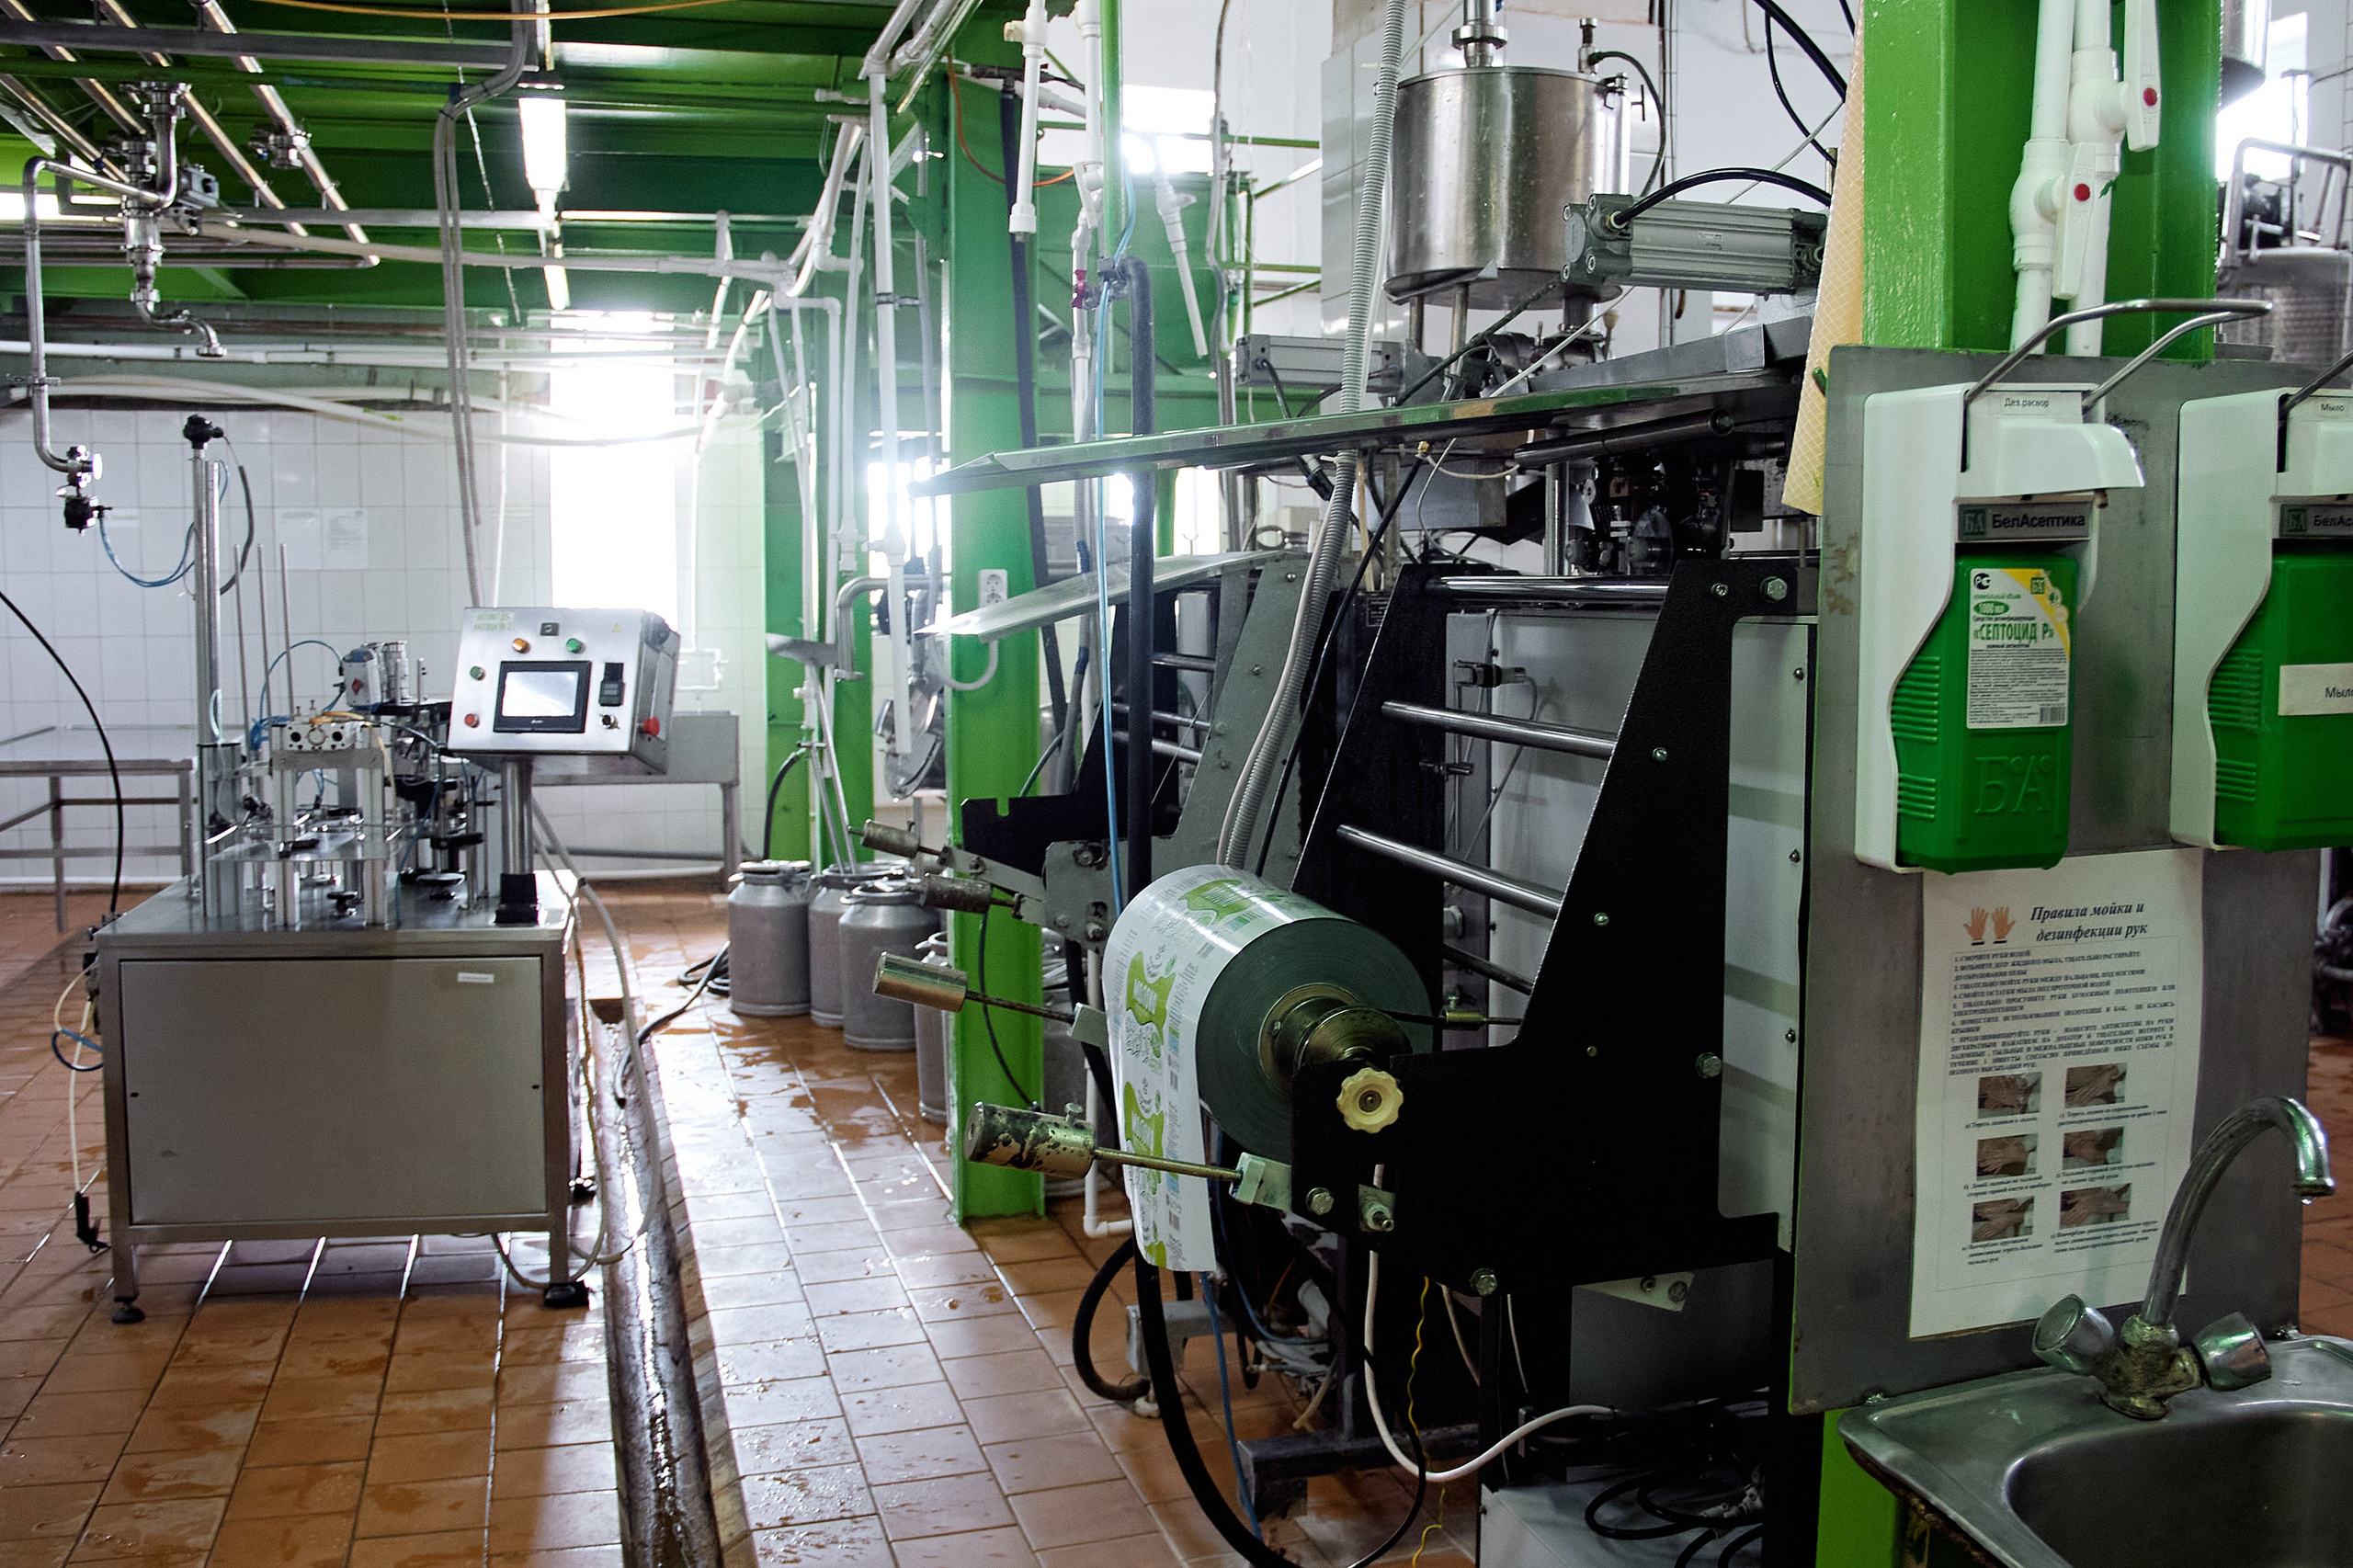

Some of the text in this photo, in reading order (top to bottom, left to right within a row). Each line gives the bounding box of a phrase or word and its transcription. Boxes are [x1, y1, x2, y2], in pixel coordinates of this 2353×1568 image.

[2321, 403, 2345, 412] Мыло
[1992, 513, 2086, 529] БелАсептика
[2030, 903, 2144, 924] Правила мойки и
[2036, 924, 2148, 942] дезинфекции рук
